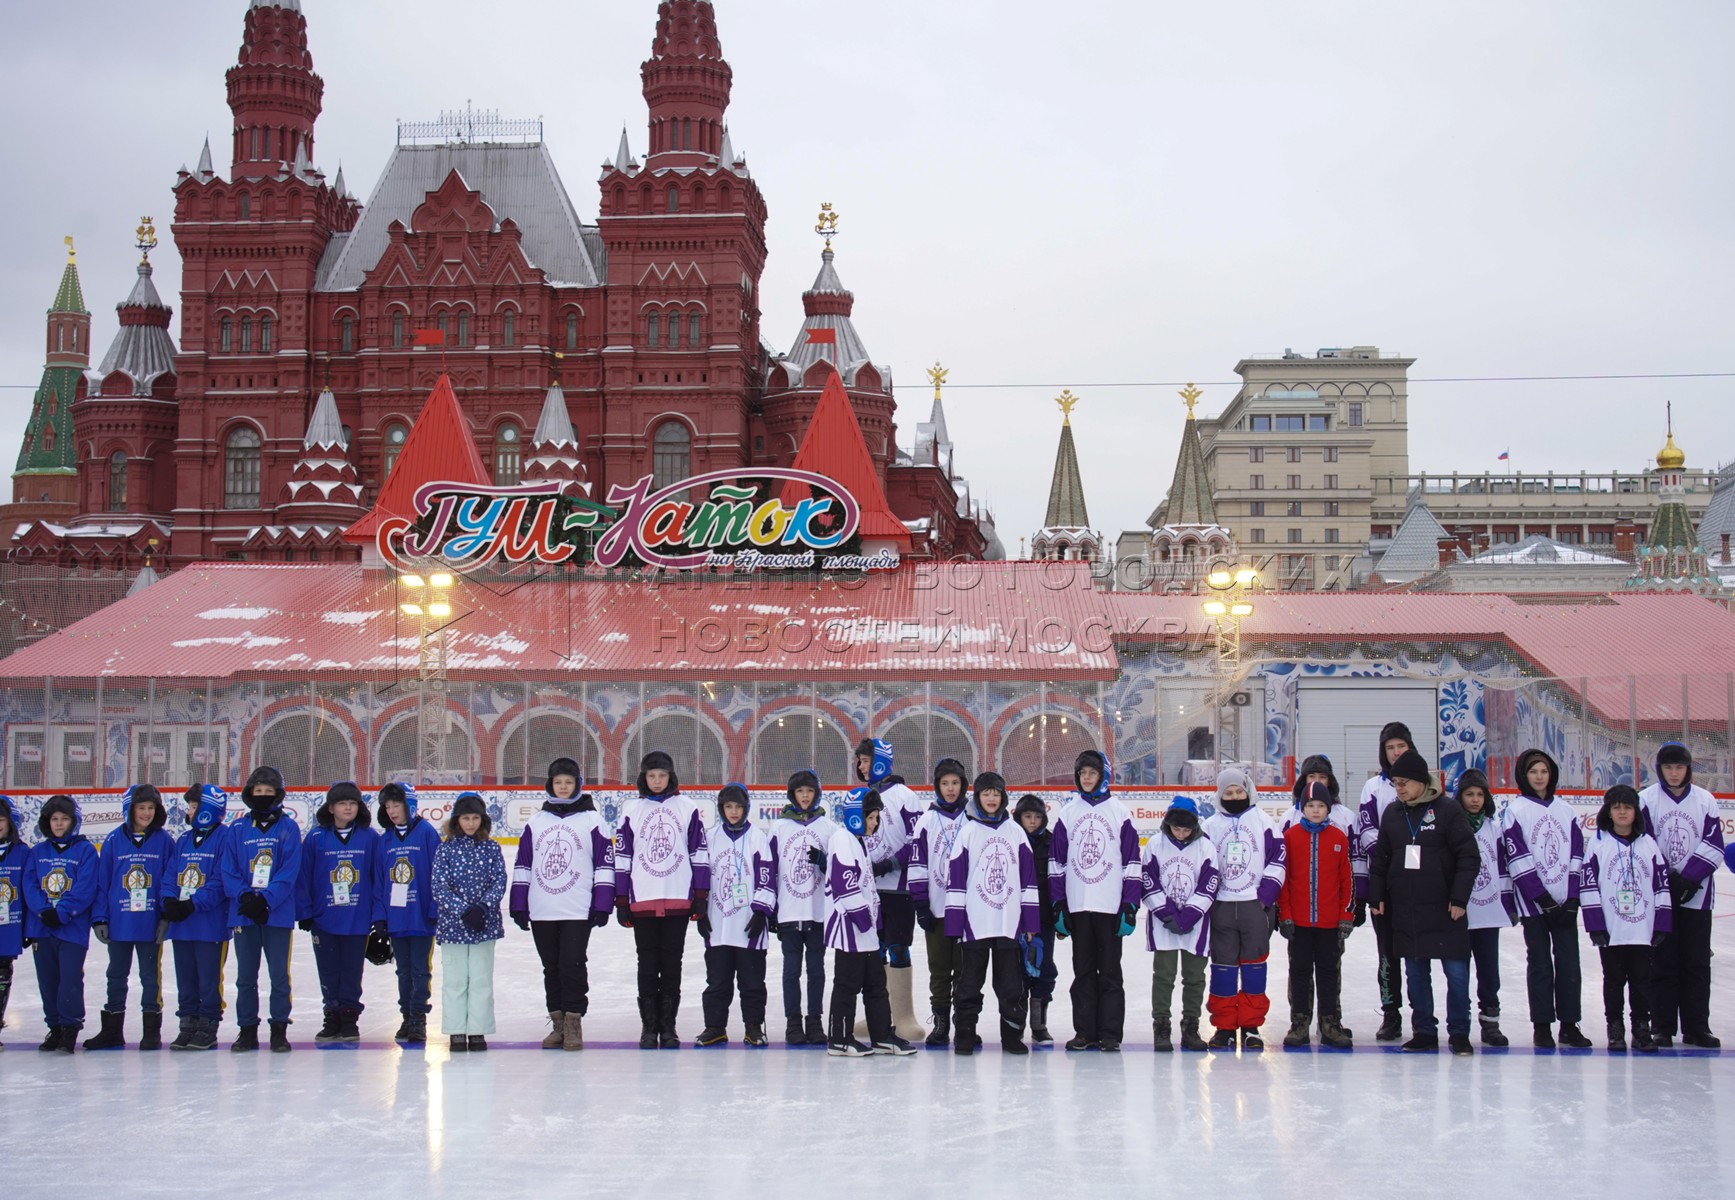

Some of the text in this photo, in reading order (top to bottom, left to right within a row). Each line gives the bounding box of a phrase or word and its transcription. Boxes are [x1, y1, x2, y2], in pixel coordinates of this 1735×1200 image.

[734, 549, 815, 573] Красной
[822, 548, 901, 572] площади
[759, 867, 770, 885] 5
[1580, 867, 1597, 887] 12
